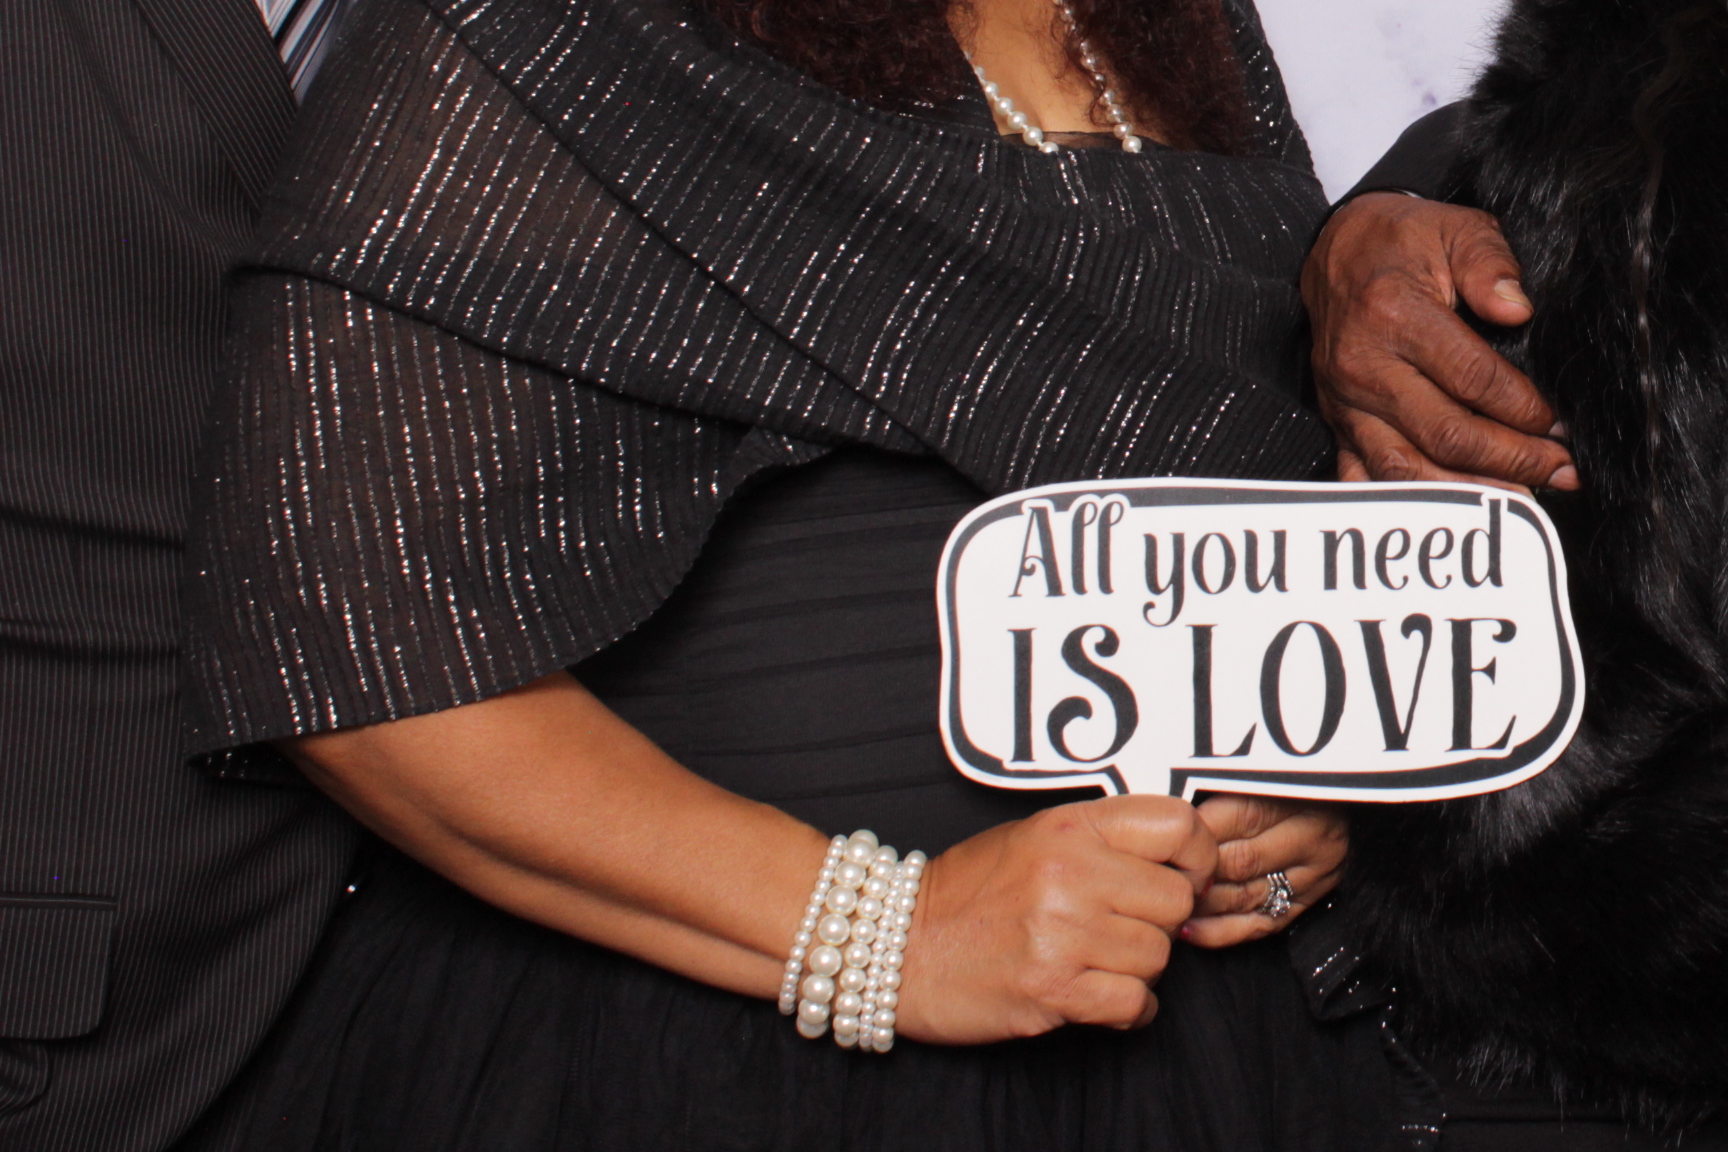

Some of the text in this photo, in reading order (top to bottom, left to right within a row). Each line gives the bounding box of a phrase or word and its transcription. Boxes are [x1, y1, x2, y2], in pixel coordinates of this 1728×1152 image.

[1007, 497, 1504, 628] All you need
[1006, 612, 1518, 763] IS LOVE
